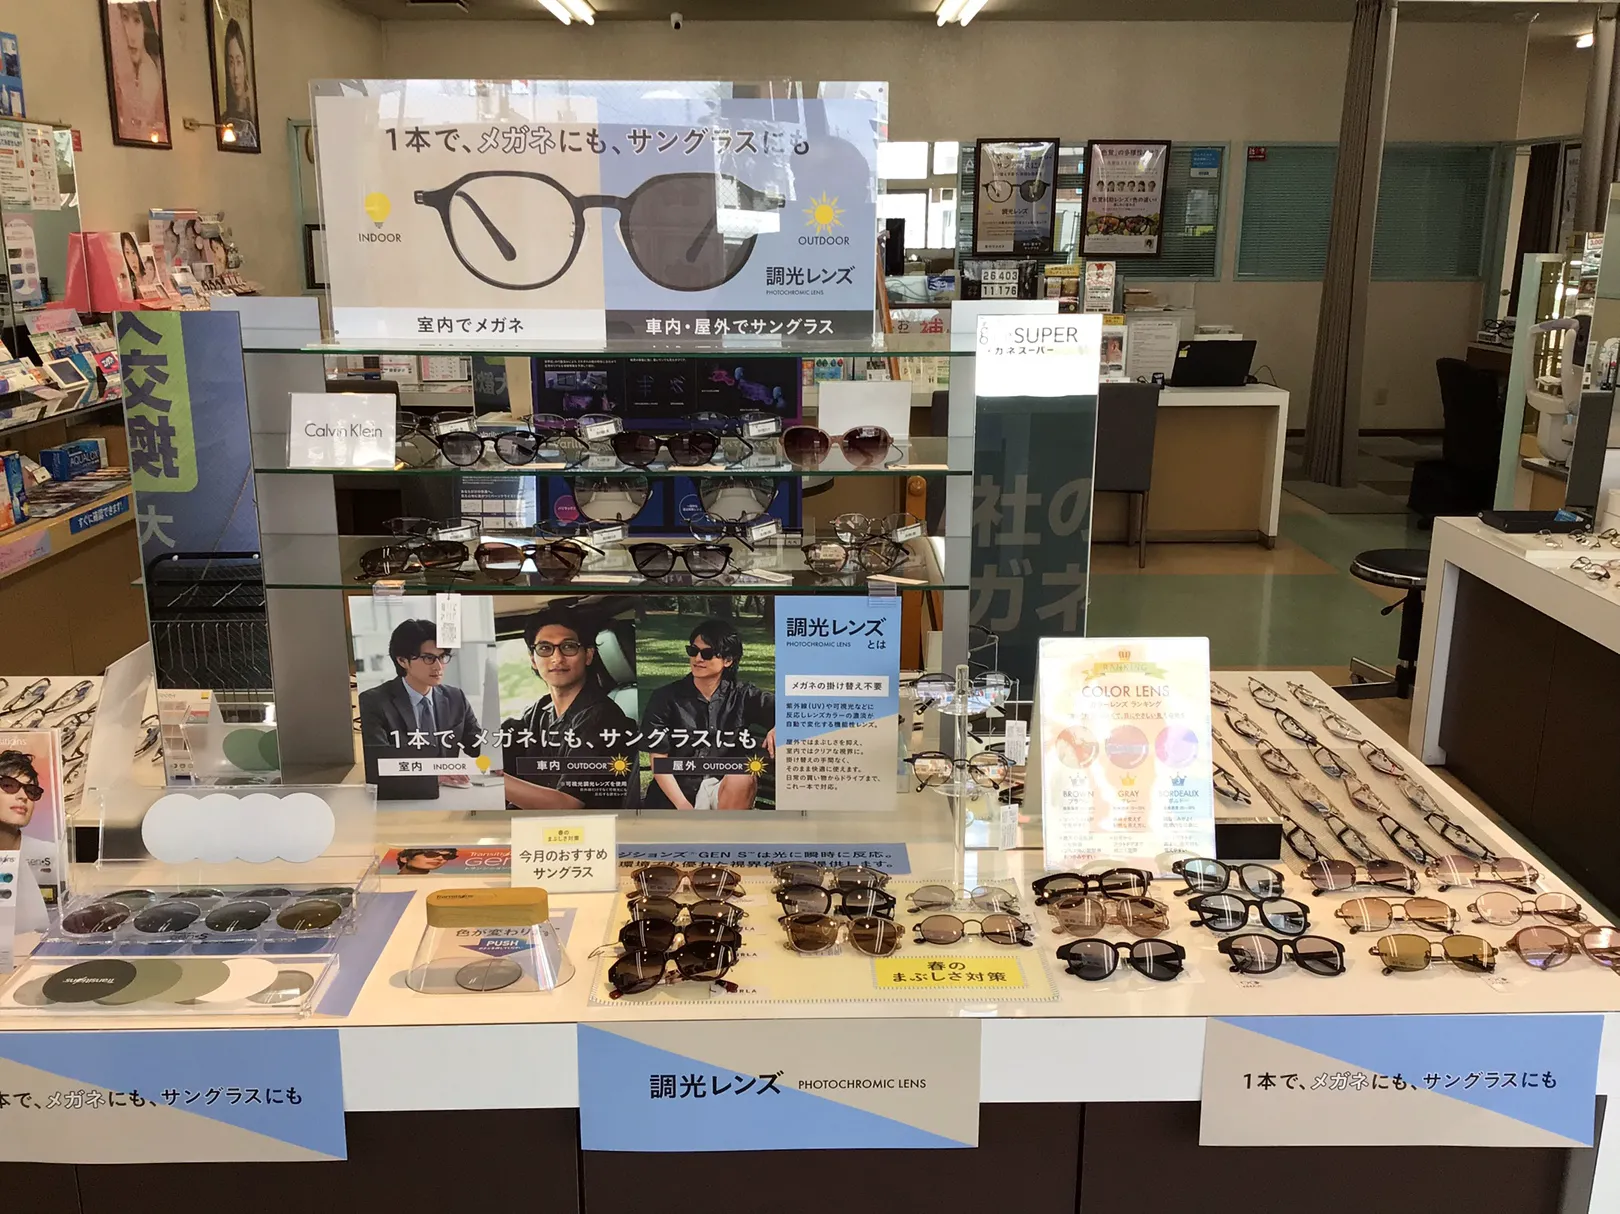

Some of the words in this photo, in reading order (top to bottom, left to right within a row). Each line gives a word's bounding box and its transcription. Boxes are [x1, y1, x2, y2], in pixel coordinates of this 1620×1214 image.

[358, 233, 402, 243] INDOOR
[798, 236, 850, 246] OUTDOOR
[766, 265, 855, 286] 調光レンズ
[417, 316, 524, 334] 室内でメガネ
[645, 317, 835, 336] 車内・屋外でサングラス
[1014, 326, 1078, 344] SUPER
[304, 423, 347, 438] Calvin
[350, 423, 382, 438] Klein
[786, 616, 887, 637] 調光レンズ
[867, 639, 887, 649] とは
[791, 682, 883, 691] メガネの掛け替え不要
[1082, 686, 1130, 697] COLOR
[1136, 686, 1170, 697] LENS
[390, 727, 757, 750] 1本で、メガネにも、サングラスにも
[398, 761, 423, 772] 室内
[433, 763, 467, 771] INDOOR
[536, 759, 561, 771] 車内
[567, 762, 608, 771] OUTDOOR
[672, 759, 697, 771] 屋外
[703, 762, 743, 771] OUTDOOR
[1117, 790, 1140, 798] GRAY
[1158, 790, 1200, 798] BORDEAUX
[519, 848, 608, 864] 今月のおすすめ
[533, 866, 594, 880] サングラス
[927, 961, 966, 971] 春の
[892, 971, 1007, 982] まぶしさ対策
[649, 1069, 784, 1099] 調光レンズ
[798, 1078, 895, 1090] PHOTOCHROMIC
[898, 1078, 927, 1089] LENS
[1243, 1070, 1558, 1092] 1本で、メガネにも、サングラスにも
